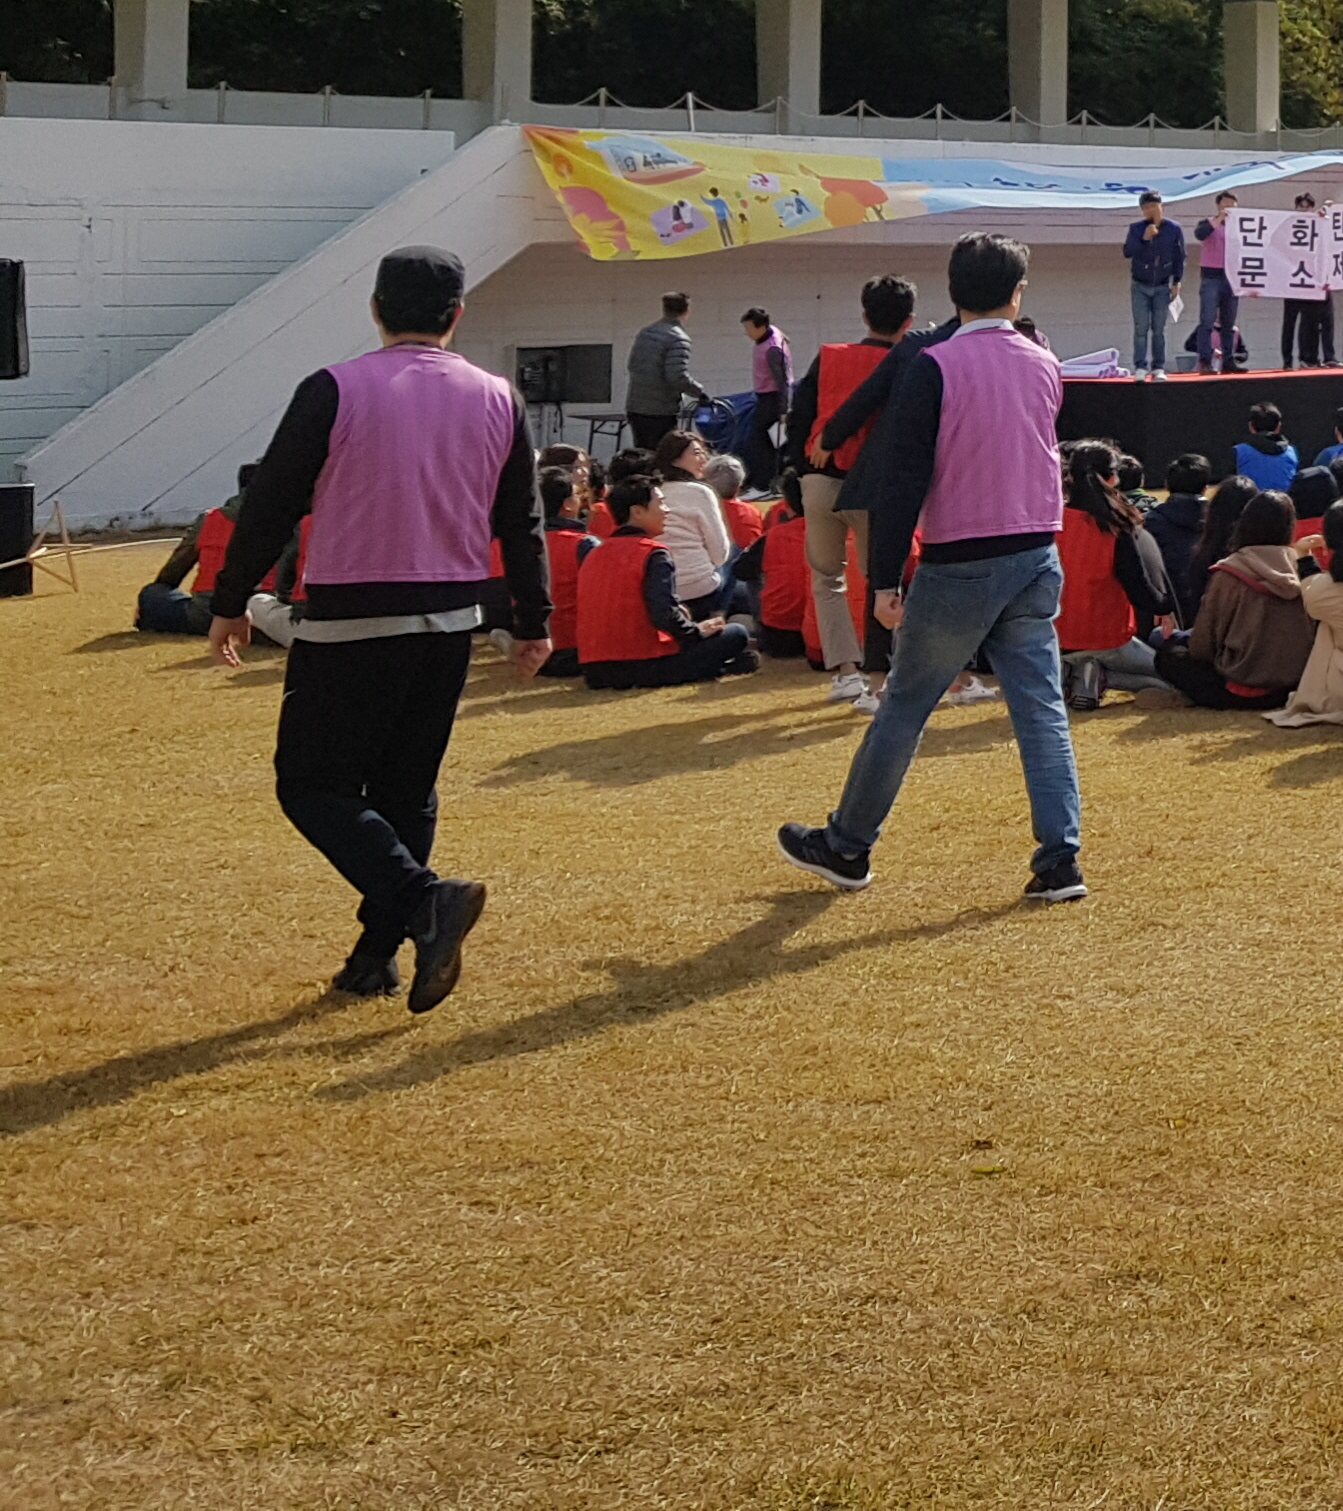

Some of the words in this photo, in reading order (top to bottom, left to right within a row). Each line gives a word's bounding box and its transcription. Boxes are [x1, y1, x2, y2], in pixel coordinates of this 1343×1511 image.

[1238, 215, 1268, 248] 단
[1289, 219, 1319, 252] 화
[1237, 256, 1268, 289] 문
[1289, 260, 1316, 289] 소
